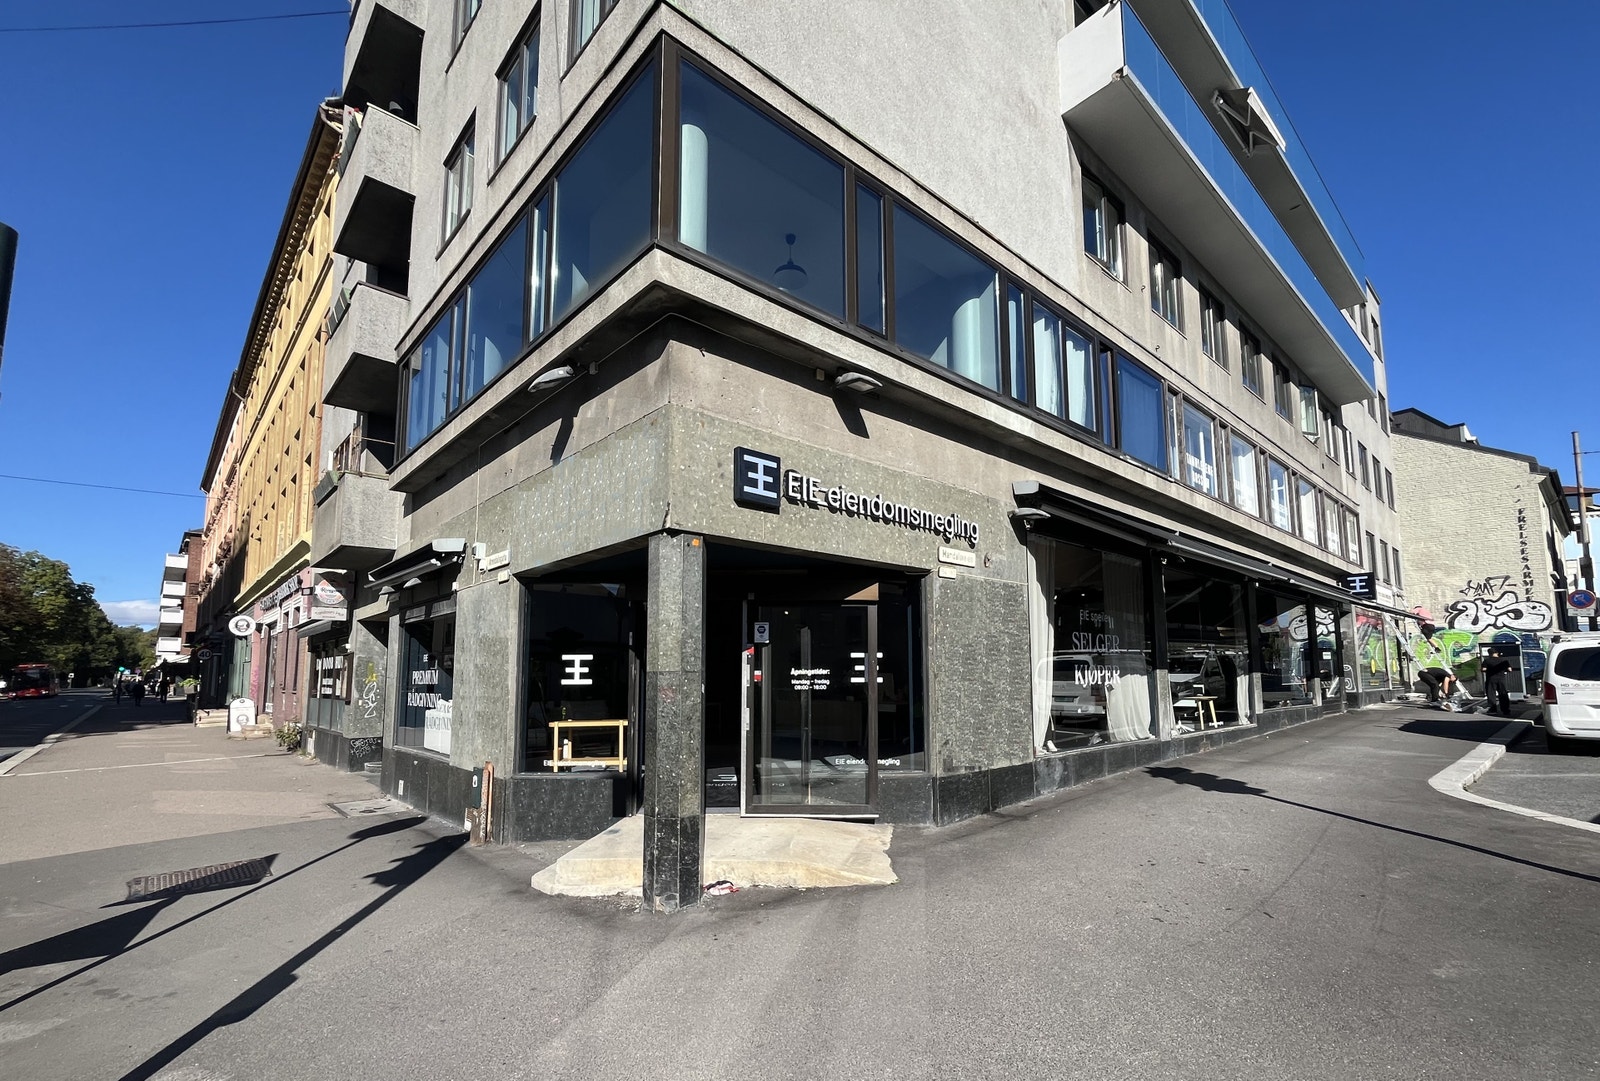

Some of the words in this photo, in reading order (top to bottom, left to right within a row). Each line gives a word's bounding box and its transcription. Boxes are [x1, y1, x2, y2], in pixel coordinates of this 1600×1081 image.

[788, 471, 828, 505] EIE
[828, 484, 979, 544] eiendomsmegling
[1072, 631, 1120, 652] SELGER
[411, 669, 439, 685] PREMIUM
[1074, 664, 1120, 687] KJØPER
